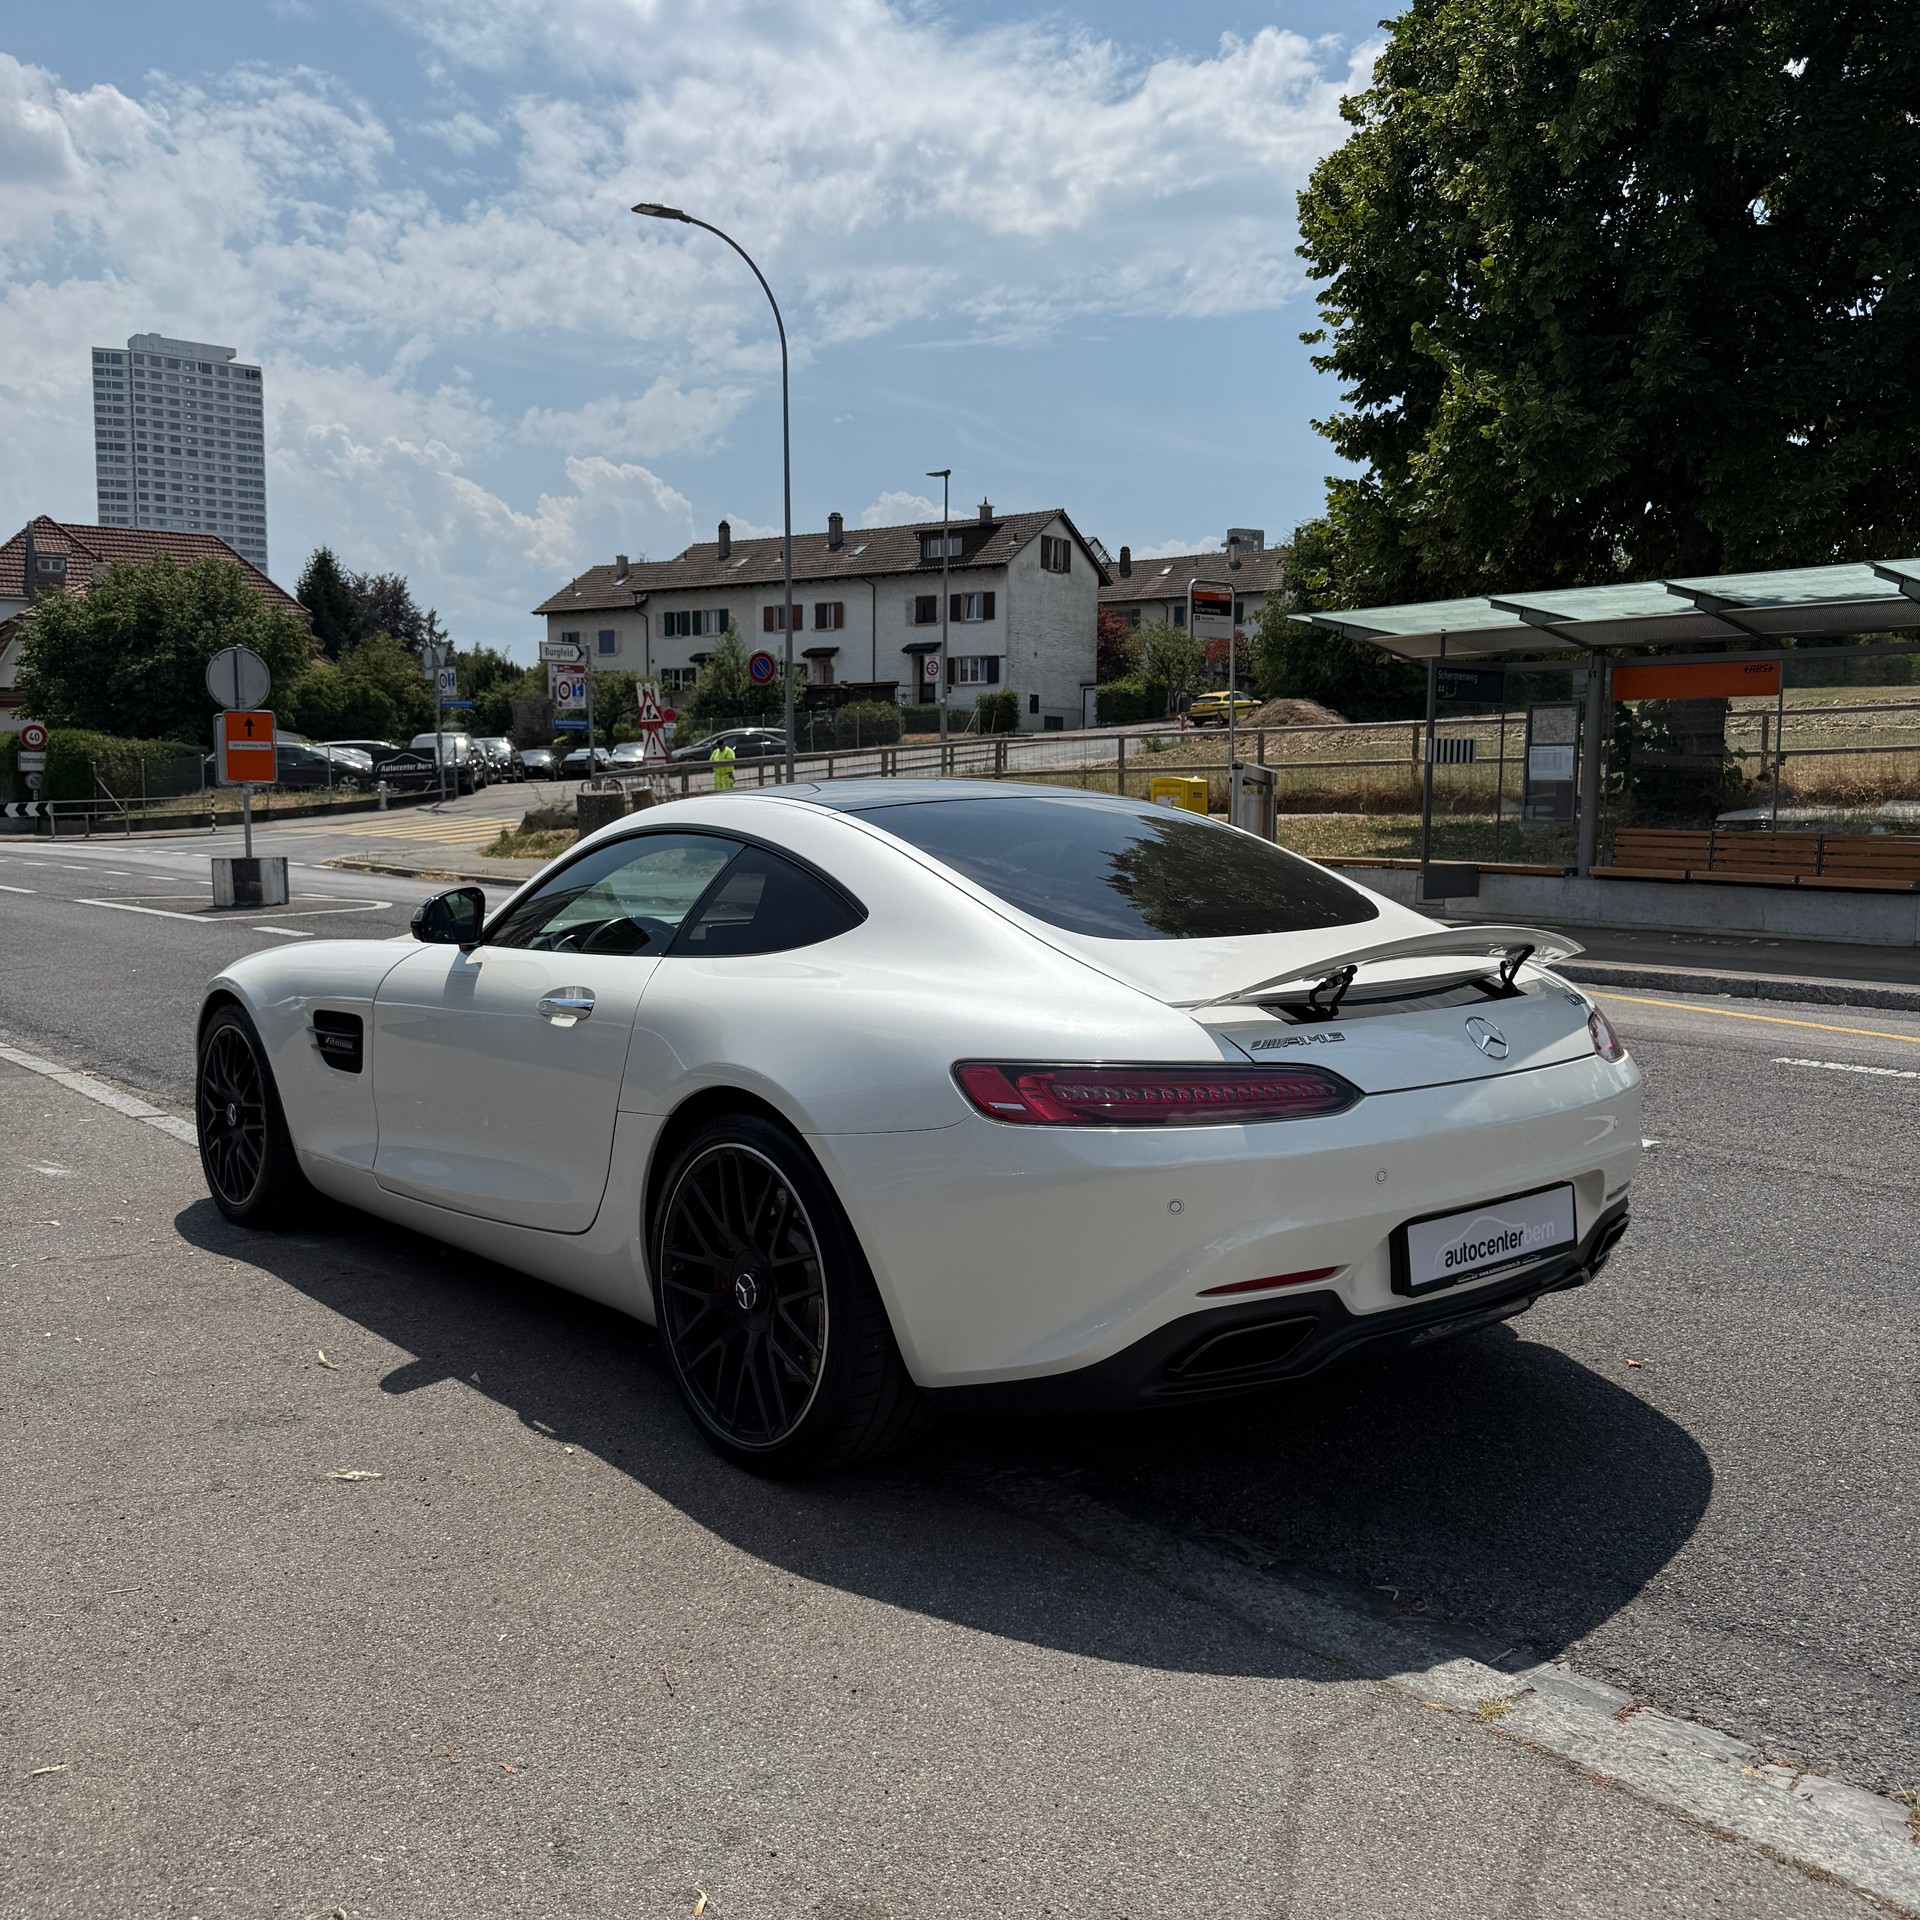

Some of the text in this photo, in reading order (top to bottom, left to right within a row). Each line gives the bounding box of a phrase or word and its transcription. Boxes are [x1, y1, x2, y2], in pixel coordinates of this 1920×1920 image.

[545, 647, 574, 659] Burgfeld
[1748, 664, 1769, 673] RBS
[1438, 669, 1478, 684] Schermenweg
[29, 732, 40, 741] 40
[381, 762, 433, 773] Autocenter Bern
[1278, 1031, 1346, 1048] AMG
